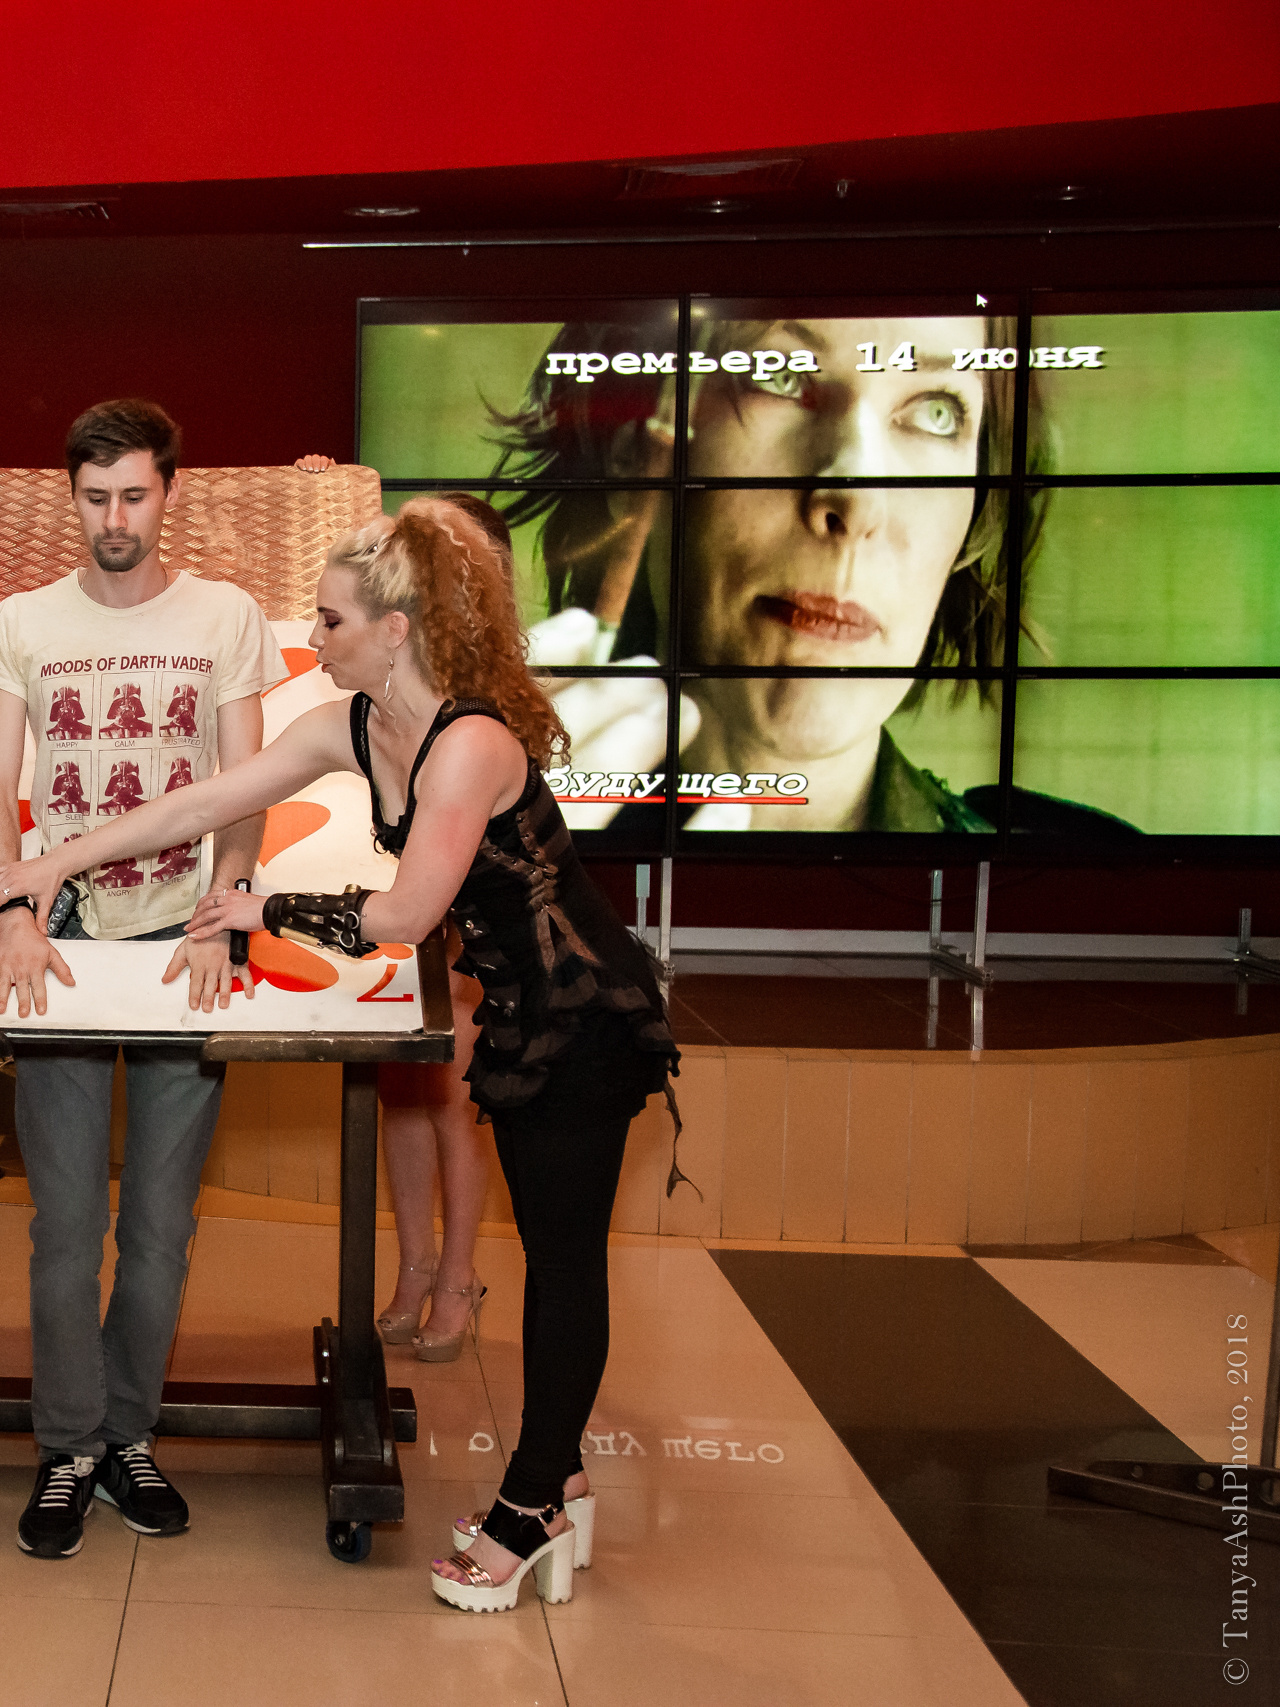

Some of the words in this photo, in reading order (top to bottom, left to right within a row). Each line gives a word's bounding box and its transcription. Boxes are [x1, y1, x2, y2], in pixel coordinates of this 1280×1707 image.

[545, 349, 820, 383] премьера
[855, 341, 917, 371] 14
[951, 345, 1106, 371] июня
[40, 659, 93, 678] MOODS
[96, 657, 117, 671] OF
[120, 655, 167, 670] DARTH
[171, 656, 214, 675] VADER
[56, 741, 79, 749] HAPPY
[114, 740, 136, 748] CALM
[545, 765, 809, 799] будущего
[65, 813, 84, 821] SLEE
[106, 889, 132, 898] ANGRY
[356, 963, 415, 1003] 7
